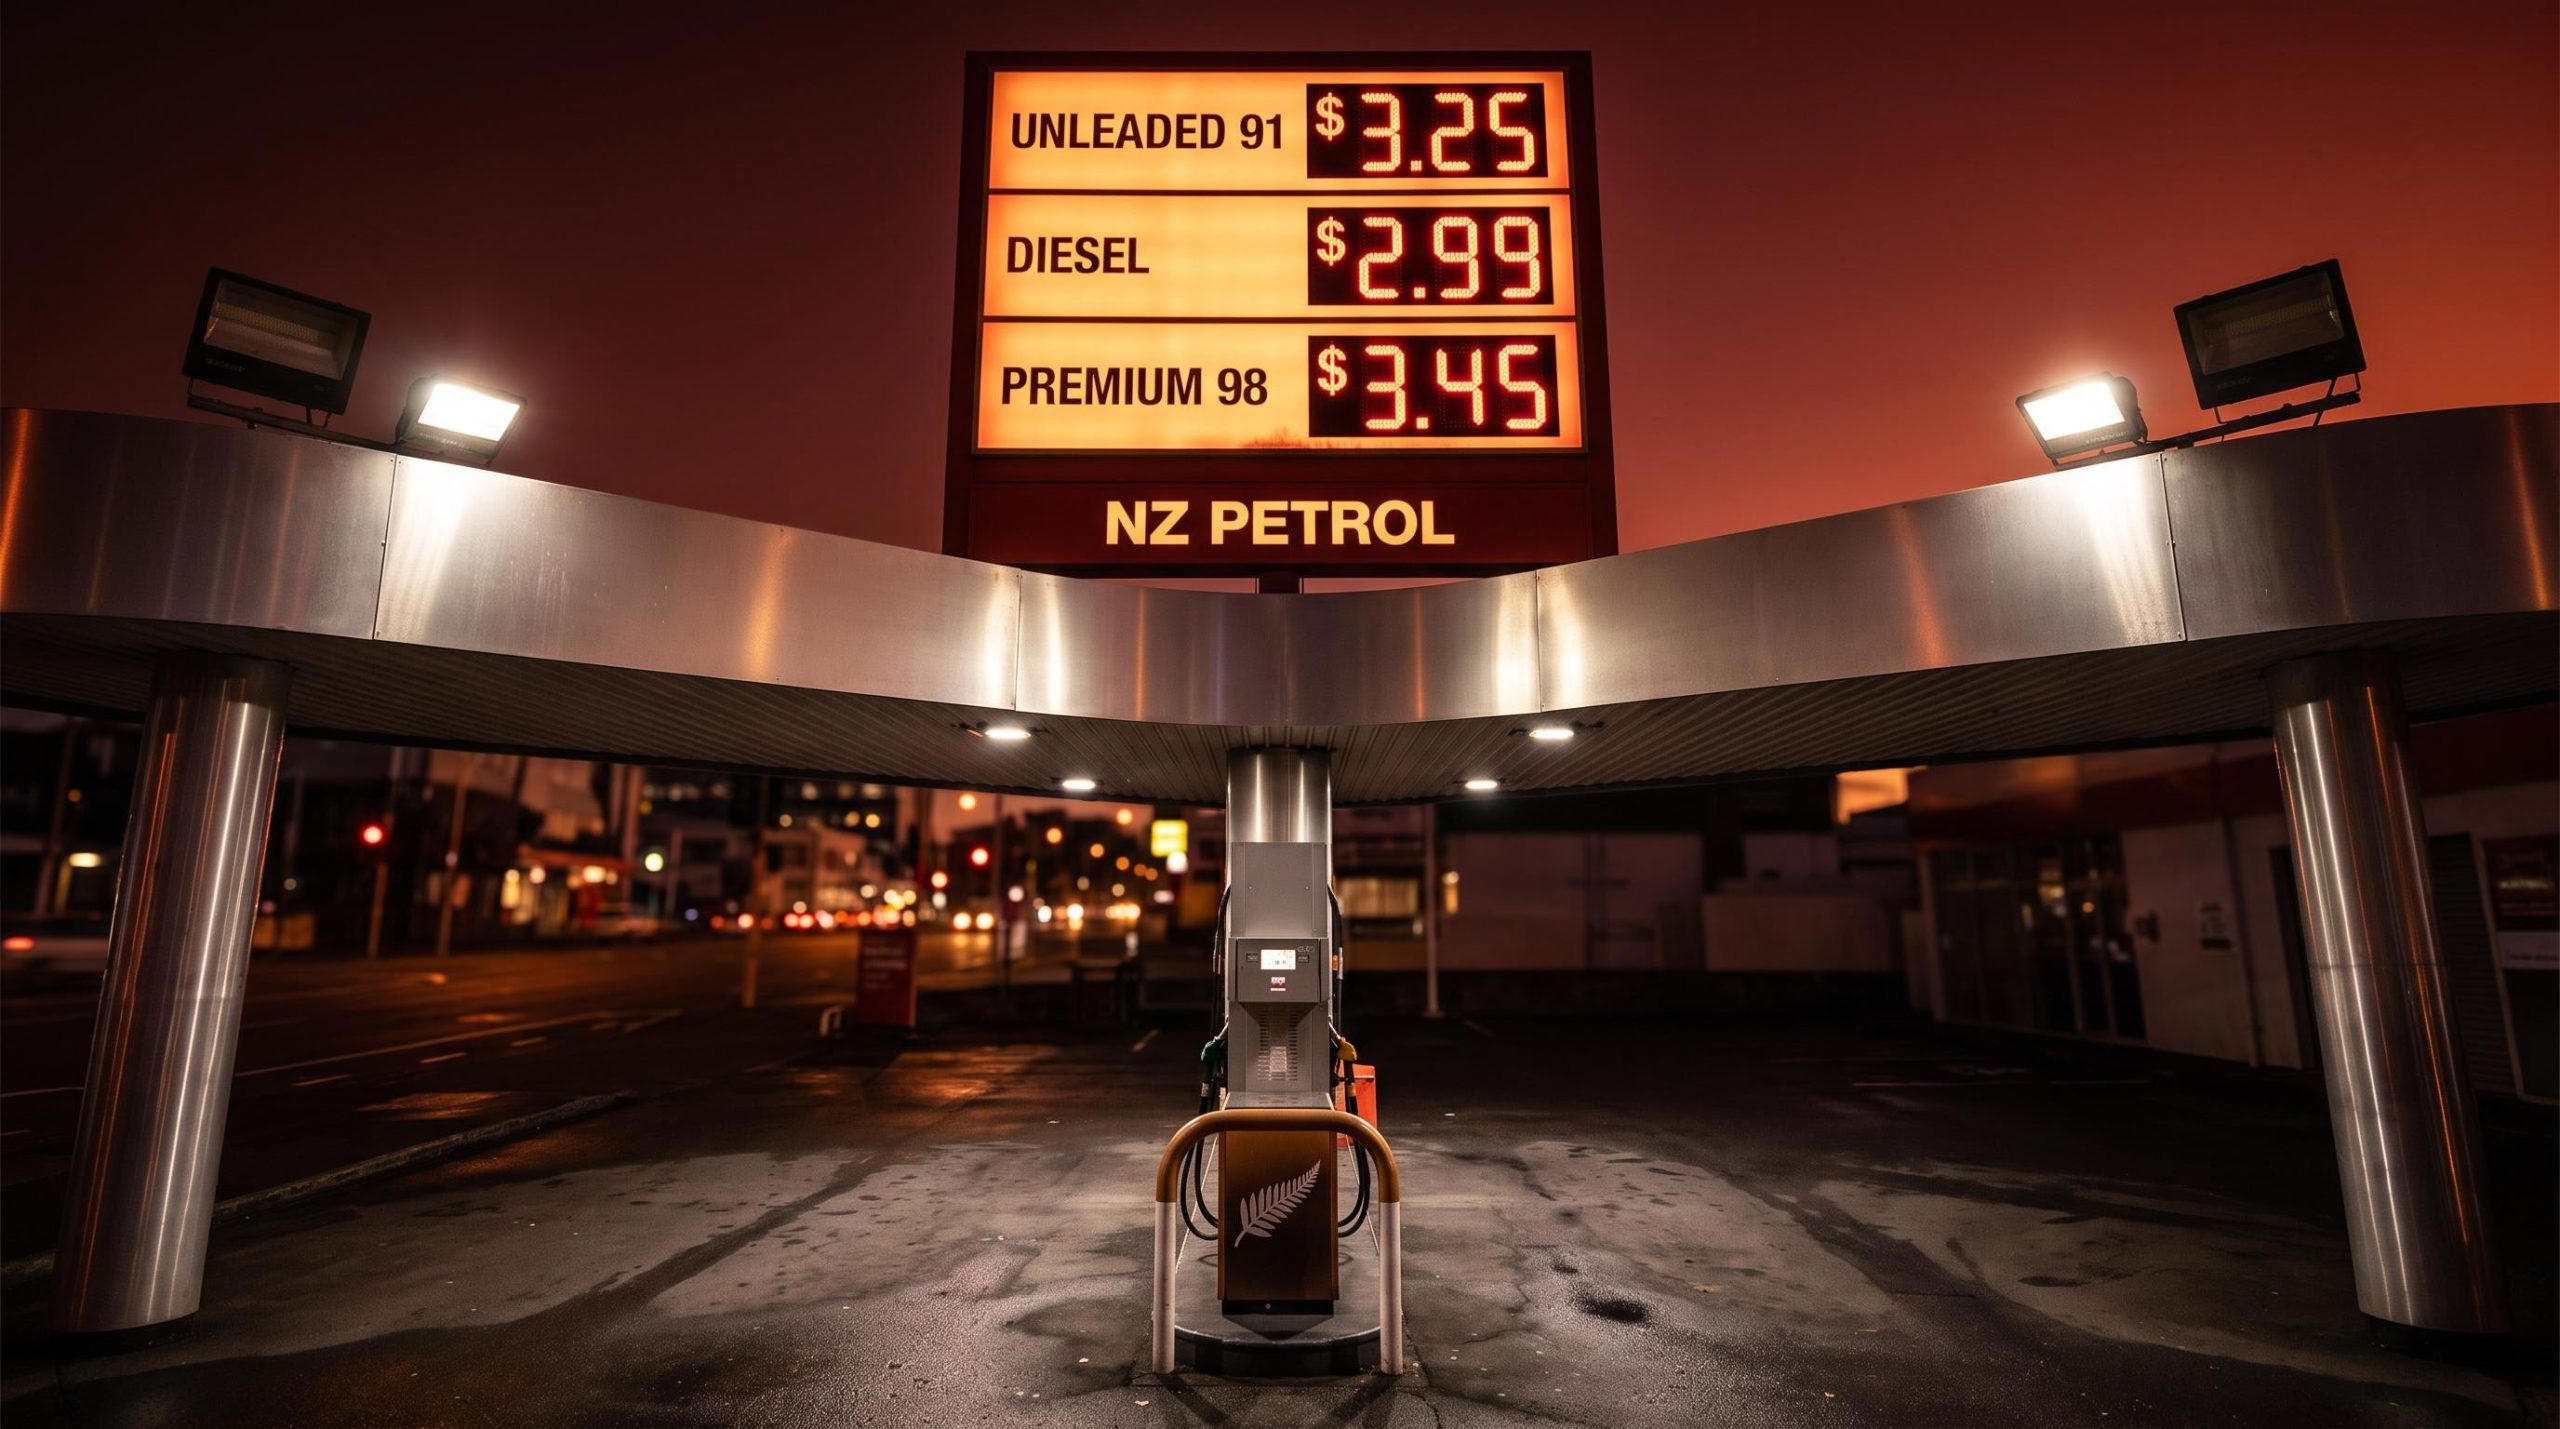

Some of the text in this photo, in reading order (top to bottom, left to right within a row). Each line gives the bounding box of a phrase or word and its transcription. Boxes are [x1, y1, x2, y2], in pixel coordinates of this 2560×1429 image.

[1011, 112, 1283, 150] UNLEADED 91
[1006, 236, 1151, 275] DIESEL
[1000, 366, 1269, 407] PREMIUM 98
[1105, 499, 1456, 547] NZ PETROL
